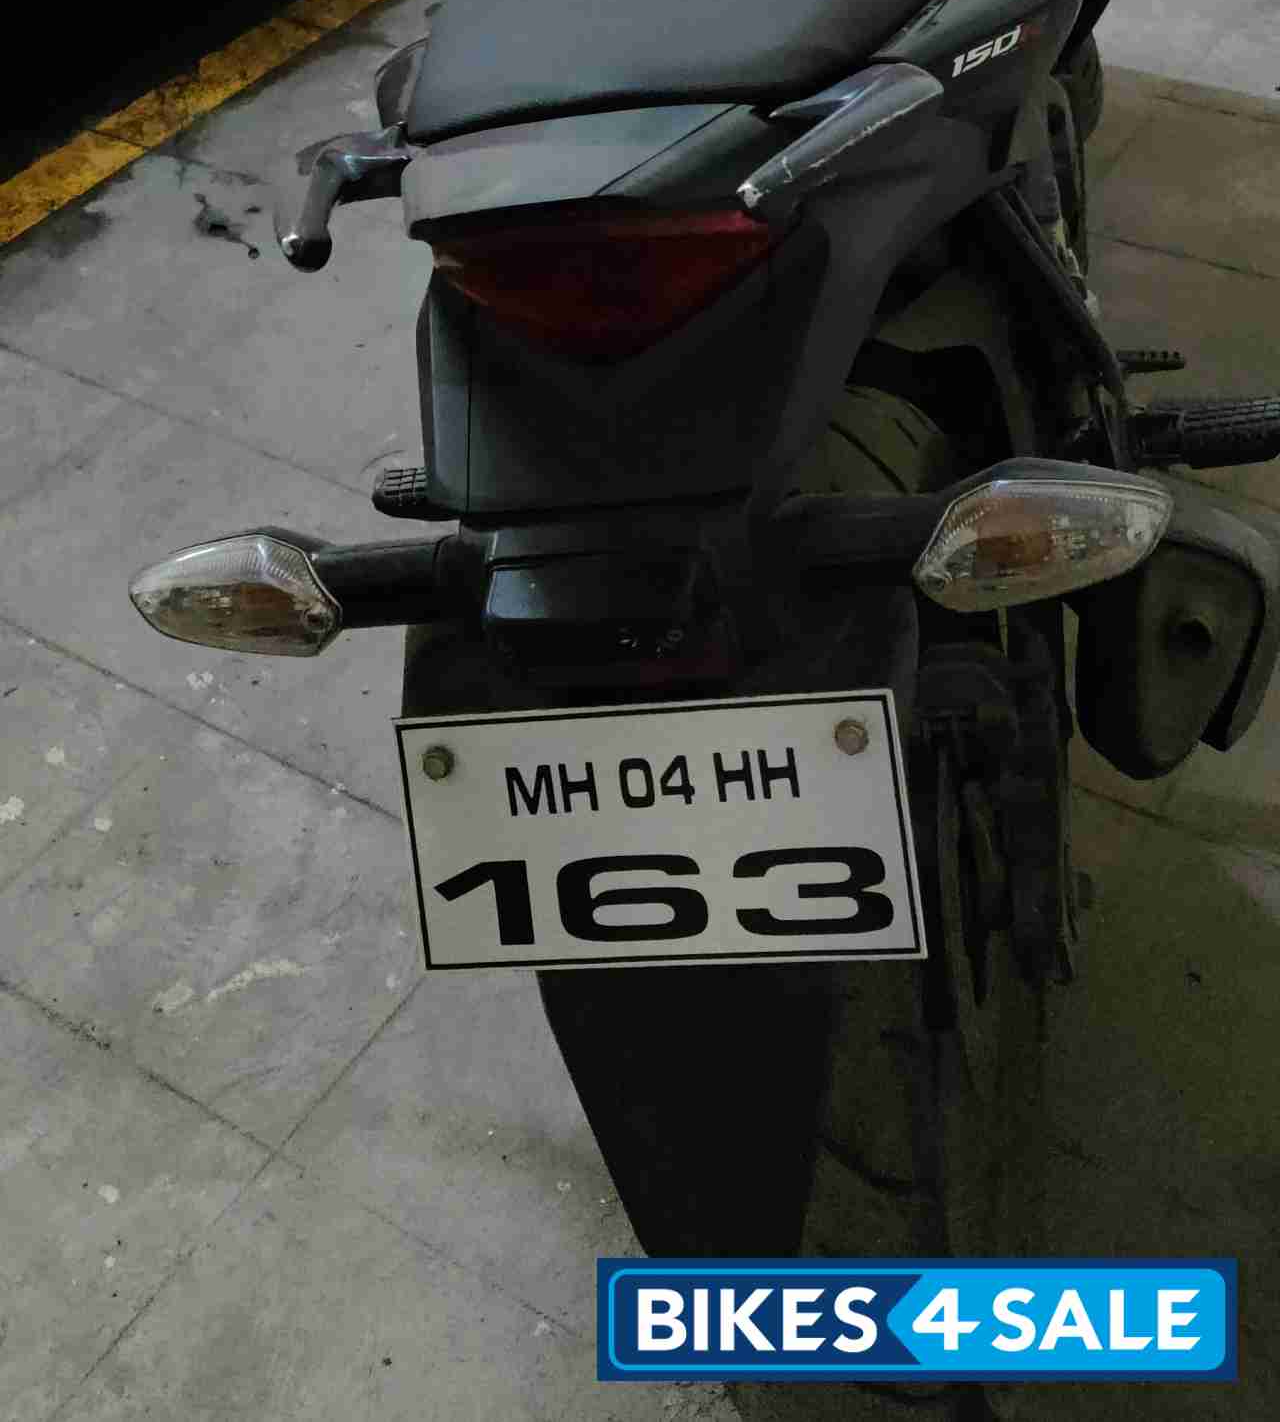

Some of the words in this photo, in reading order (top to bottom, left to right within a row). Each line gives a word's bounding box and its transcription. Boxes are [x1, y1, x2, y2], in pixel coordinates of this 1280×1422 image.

[952, 21, 1041, 78] 150
[504, 761, 600, 817] MH
[618, 754, 696, 809] 04
[712, 746, 801, 803] HH
[433, 846, 895, 946] 163
